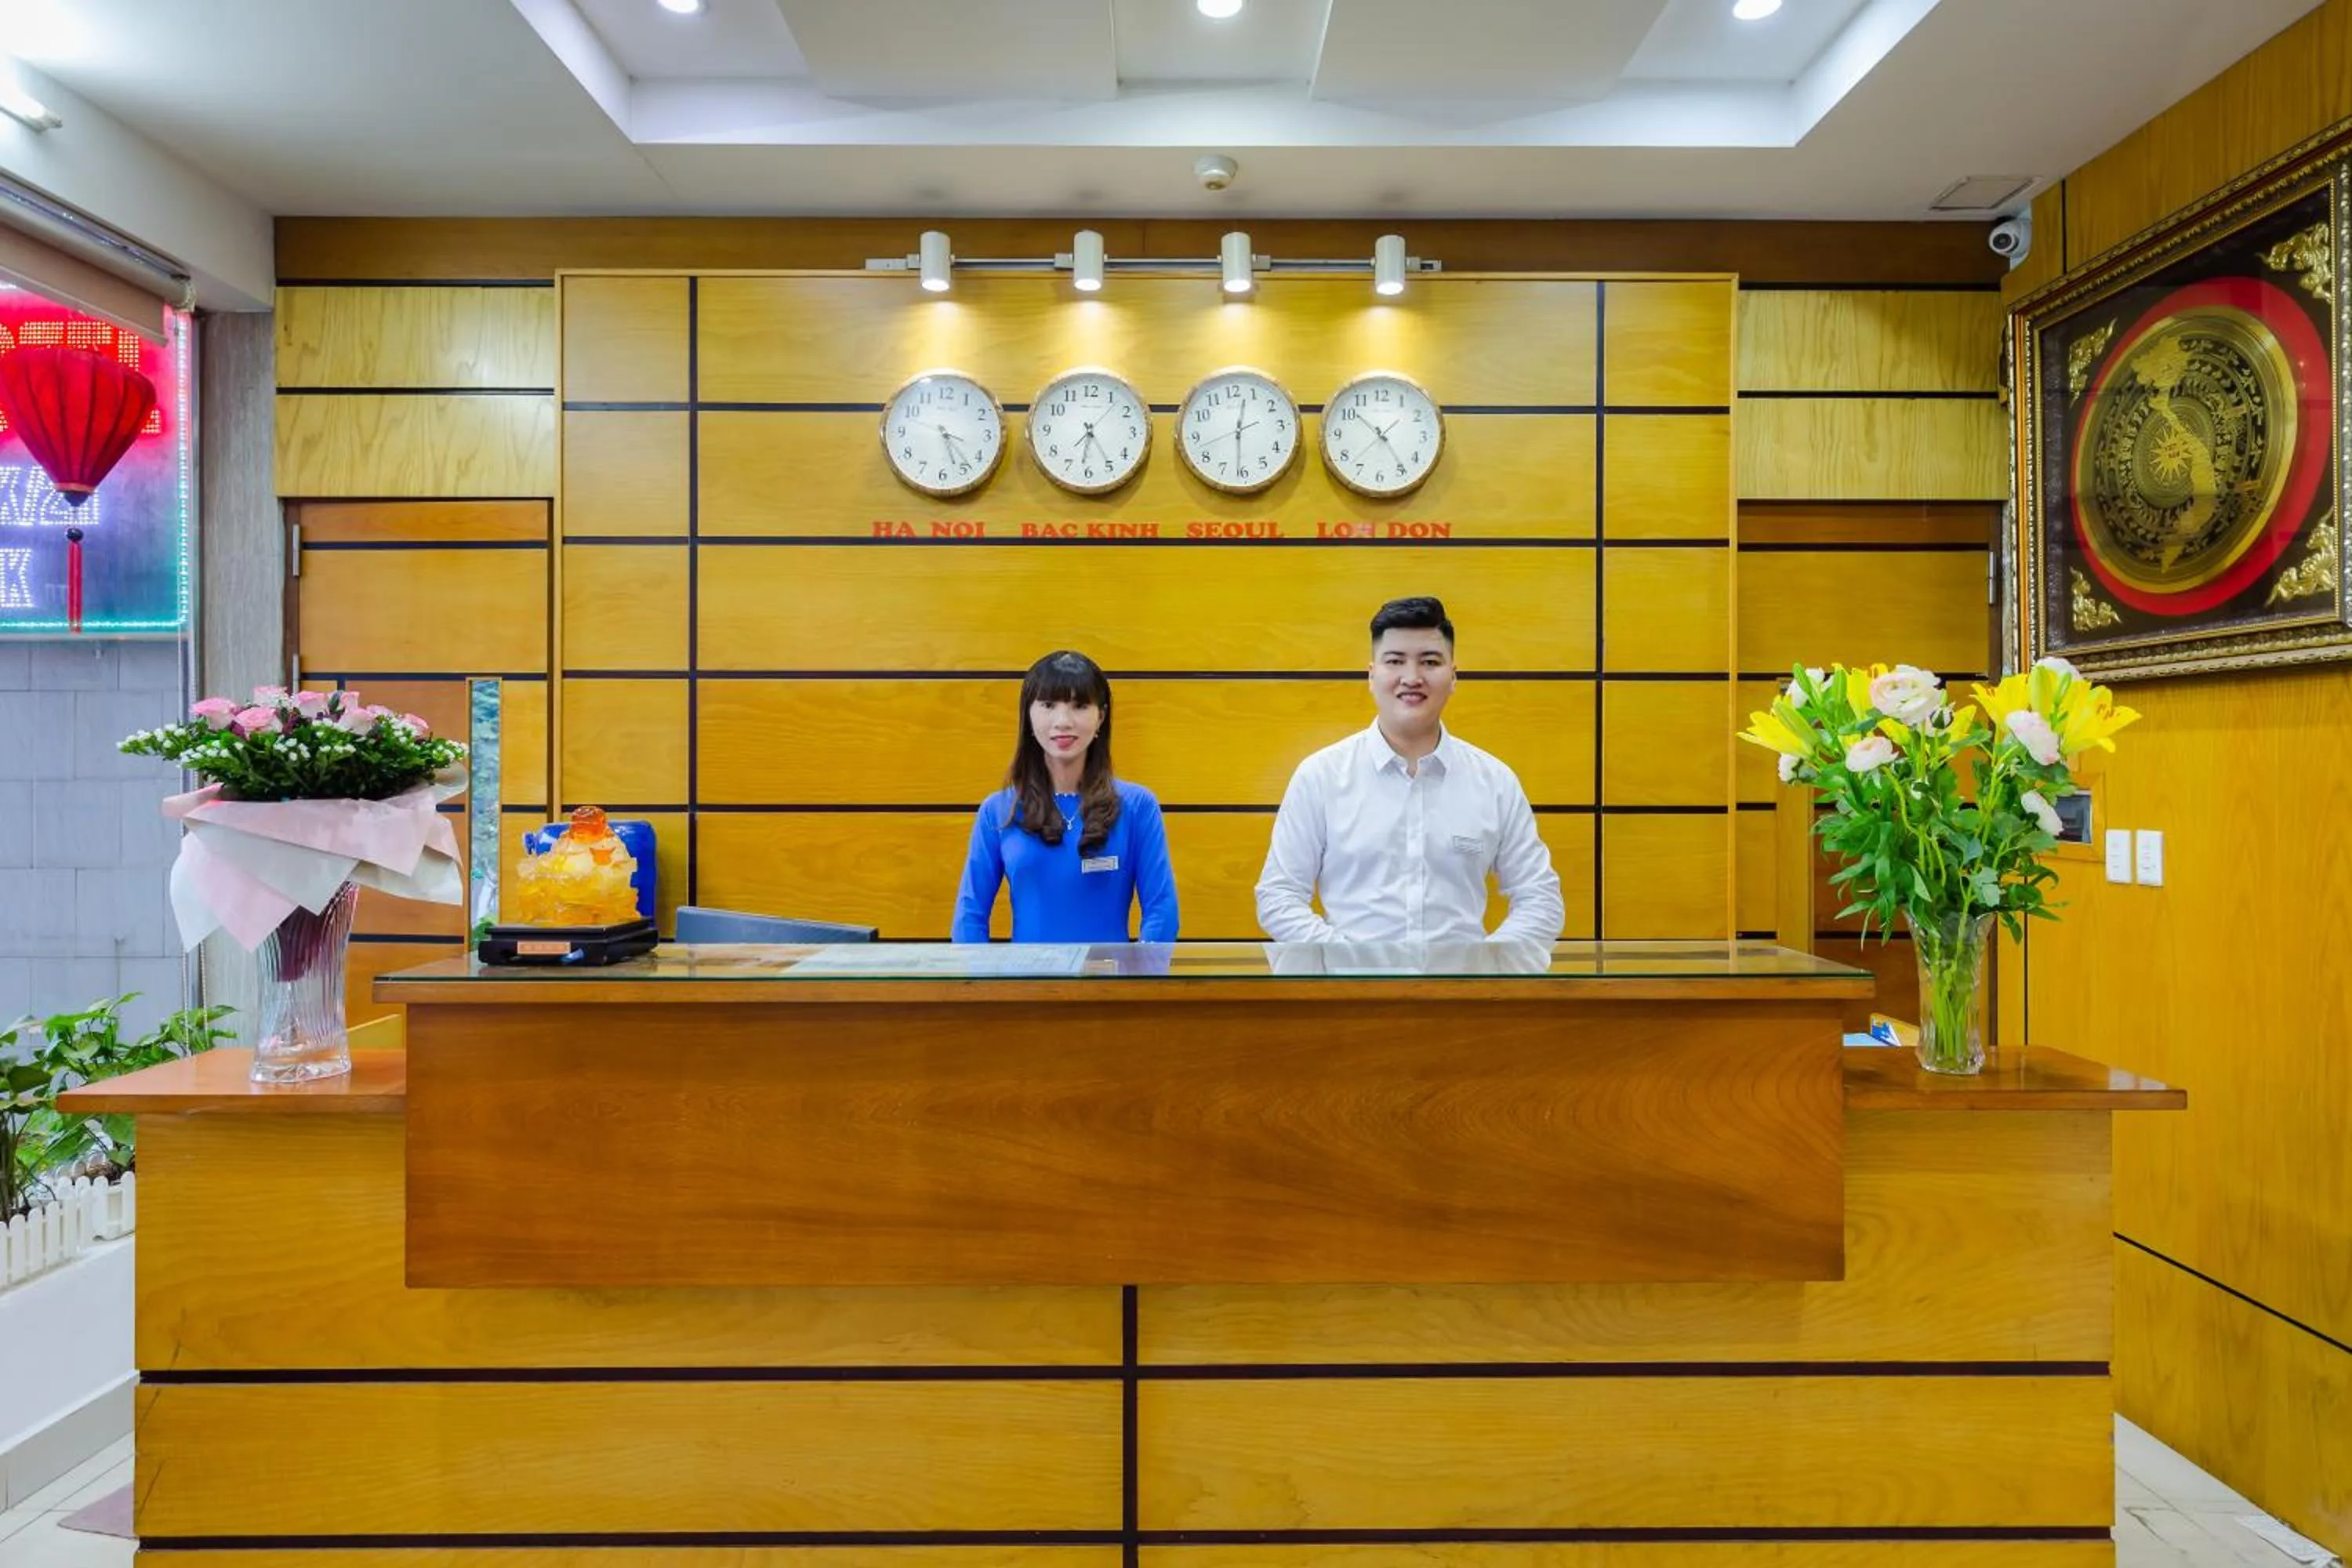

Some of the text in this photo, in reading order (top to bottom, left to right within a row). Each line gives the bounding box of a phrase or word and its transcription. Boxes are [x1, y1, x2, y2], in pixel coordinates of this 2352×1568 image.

[939, 387, 953, 399] 12
[1064, 390, 1076, 401] 11
[1083, 386, 1098, 397] 12
[1108, 392, 1114, 403] 1
[1225, 386, 1240, 398] 12
[1250, 388, 1258, 400] 1
[1374, 390, 1389, 401] 12
[920, 392, 931, 404] 11
[964, 394, 969, 406] 1
[1207, 394, 1219, 406] 11
[1355, 394, 1367, 406] 11
[1399, 394, 1404, 407] 1
[905, 405, 920, 418] 10
[1051, 404, 1065, 416] 10
[1122, 406, 1131, 417] 2
[1267, 399, 1276, 412] 2
[978, 408, 986, 420] 2
[1196, 409, 1210, 422] 10
[1342, 408, 1355, 420] 10
[1413, 409, 1421, 422] 2
[898, 426, 906, 437] 9
[1043, 425, 1051, 436] 9
[1277, 419, 1285, 433] 3
[983, 430, 991, 443] 3
[1129, 426, 1136, 439] 3
[1192, 431, 1200, 444] 9
[1334, 428, 1342, 441] 9
[1419, 430, 1427, 443] 3
[903, 446, 912, 459] 8
[1049, 445, 1058, 457] 8
[1120, 447, 1128, 459] 4
[1272, 441, 1279, 453] 4
[975, 450, 982, 463] 4
[1202, 451, 1210, 463] 8
[1340, 450, 1348, 461] 8
[1411, 452, 1418, 463] 4
[919, 461, 927, 474] 7
[1065, 459, 1073, 470] 7
[1105, 460, 1113, 472] 5
[1218, 462, 1227, 475] 7
[1258, 456, 1267, 469] 5
[938, 468, 947, 480] 6
[960, 463, 968, 475] 5
[1084, 466, 1093, 478] 6
[1240, 466, 1249, 477] 6
[1356, 463, 1364, 475] 7
[1376, 470, 1384, 482] 6
[873, 521, 985, 538] HA NOI
[1022, 522, 1159, 538] BAC KINH
[1186, 521, 1285, 538] SEOUL
[1388, 521, 1451, 538] DON
